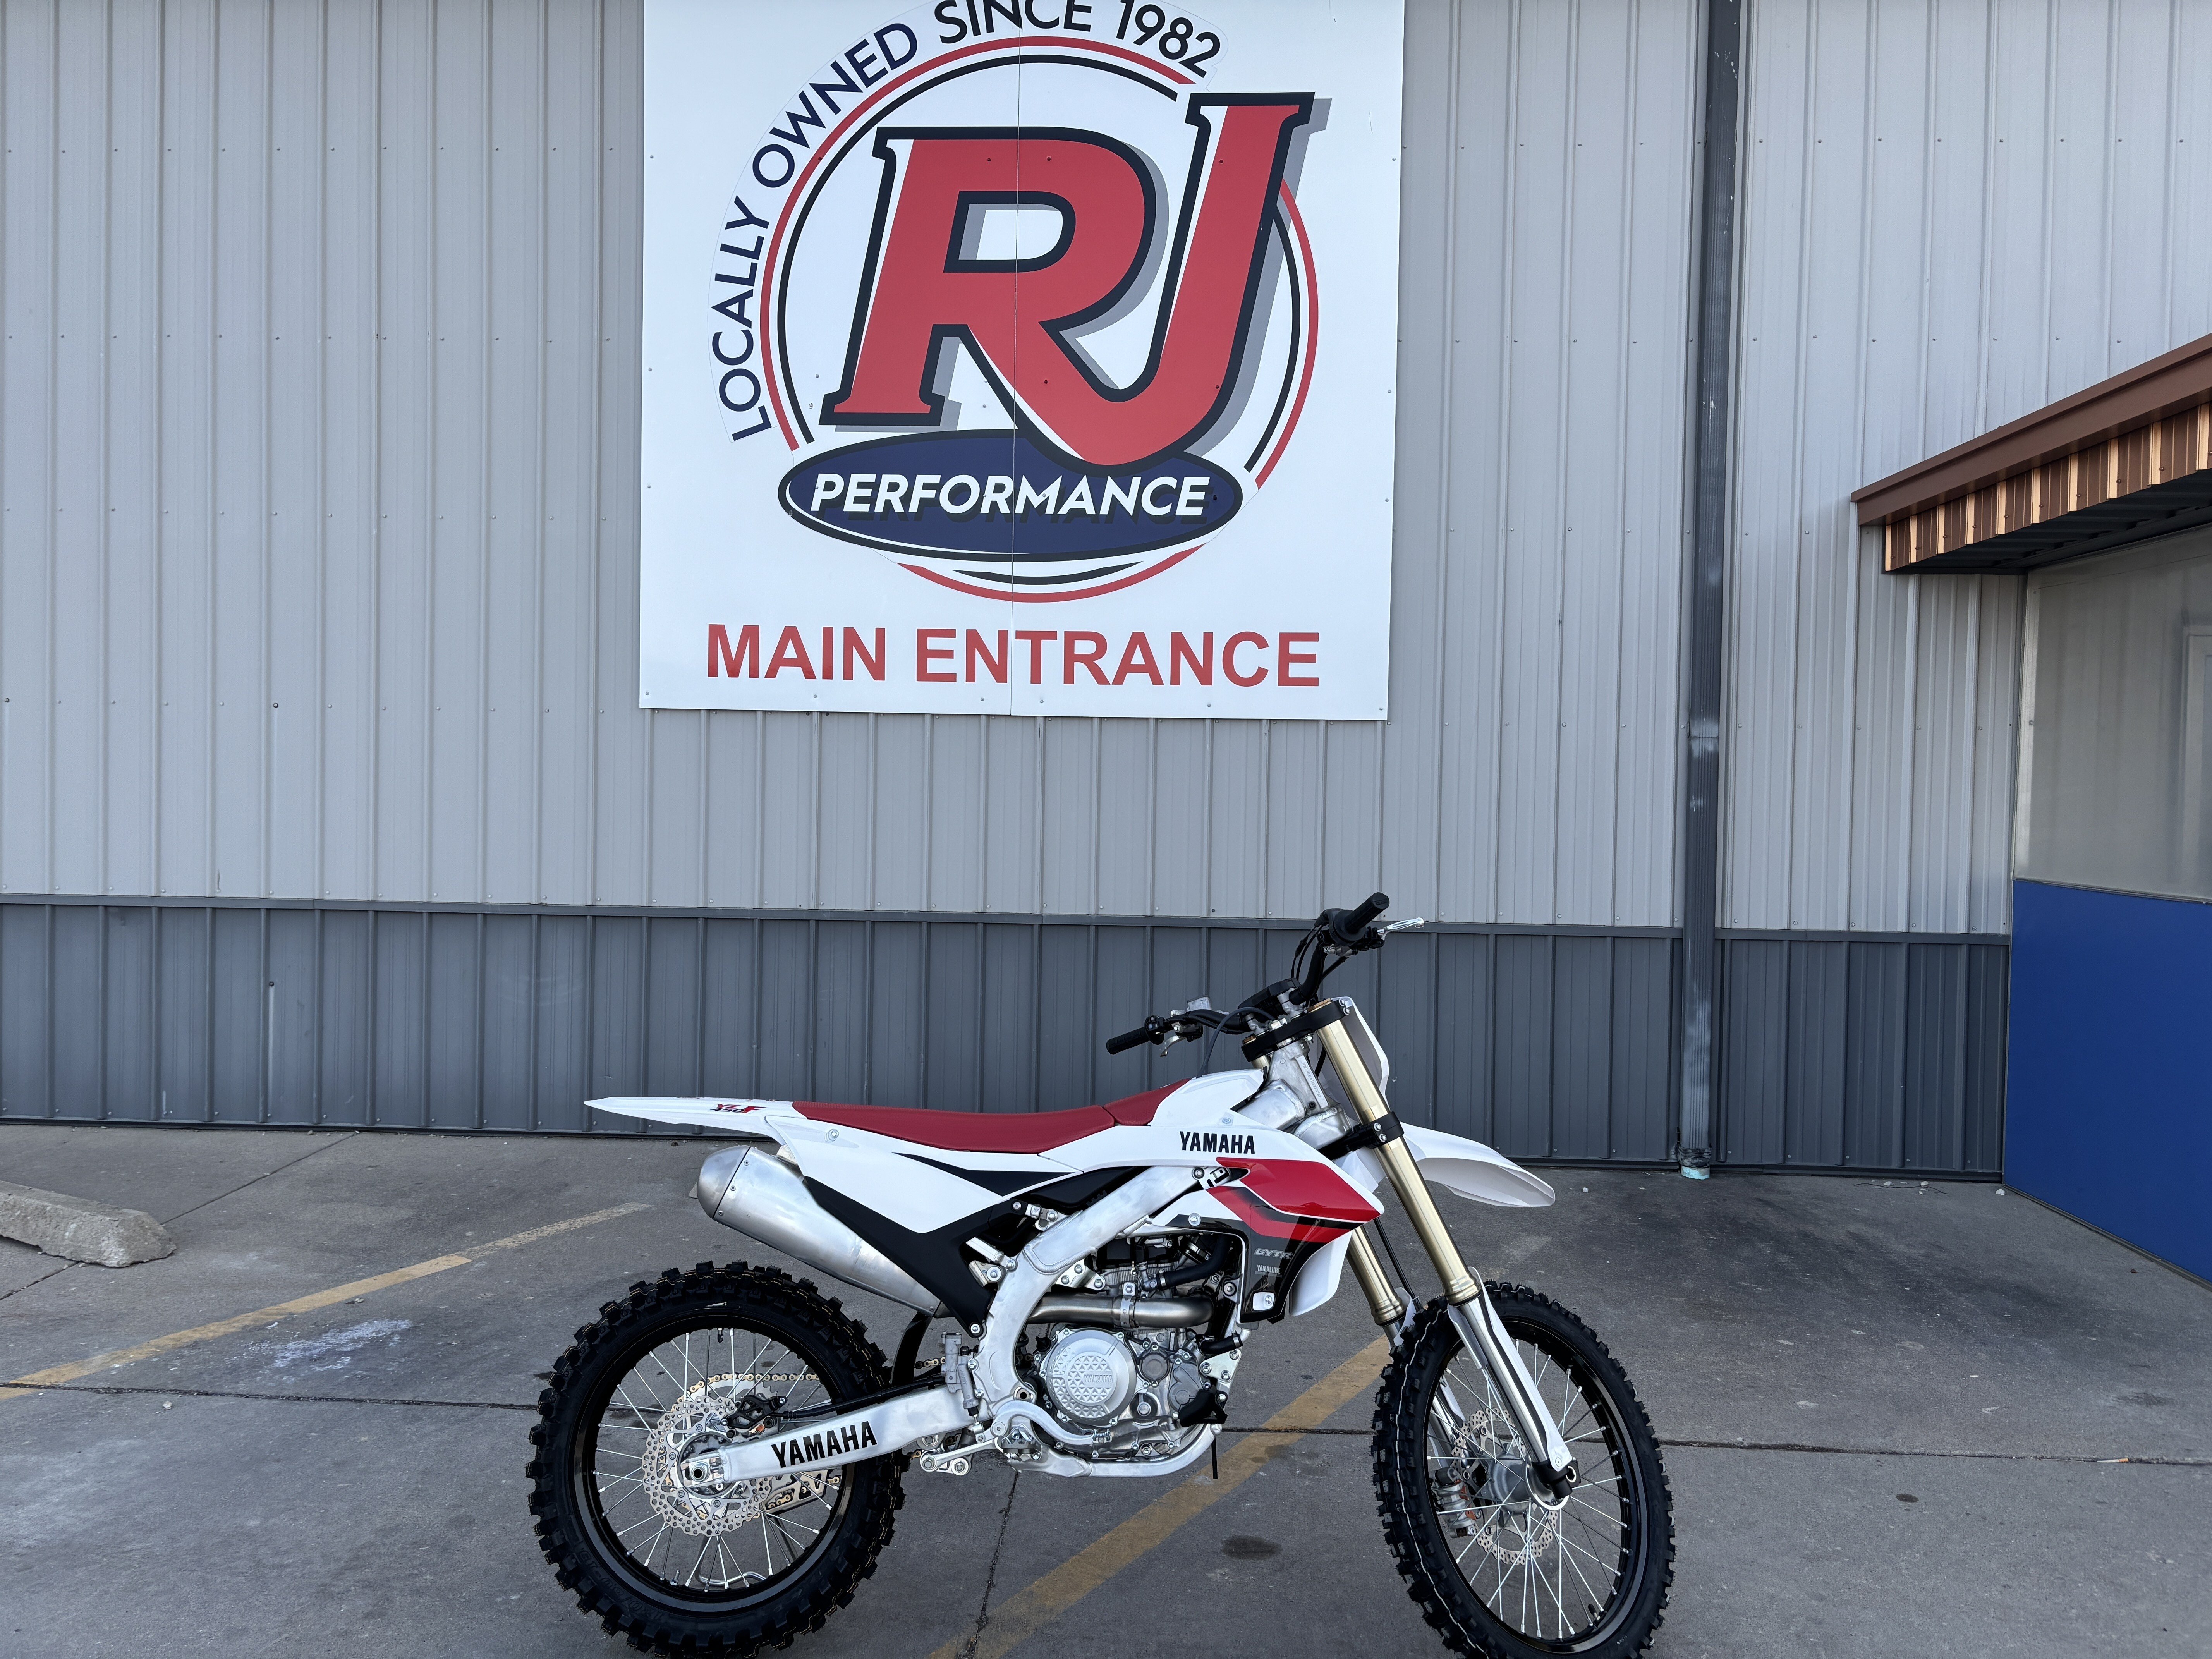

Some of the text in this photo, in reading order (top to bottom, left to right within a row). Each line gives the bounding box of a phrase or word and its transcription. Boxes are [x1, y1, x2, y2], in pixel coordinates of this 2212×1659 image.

[711, 0, 1220, 441] LOCALLY OWNED SINCE 1982
[819, 92, 1316, 476] RJ
[810, 473, 1211, 516] PERFORMANCE
[708, 625, 1319, 687] MAIN ENTRANCE
[1180, 1131, 1255, 1154] YAMAHA
[1254, 1248, 1293, 1259] GYTR
[1257, 1264, 1281, 1274] YAMALUBE
[1084, 1374, 1113, 1383] YAMAHA
[770, 1420, 878, 1469] YAMAHA
